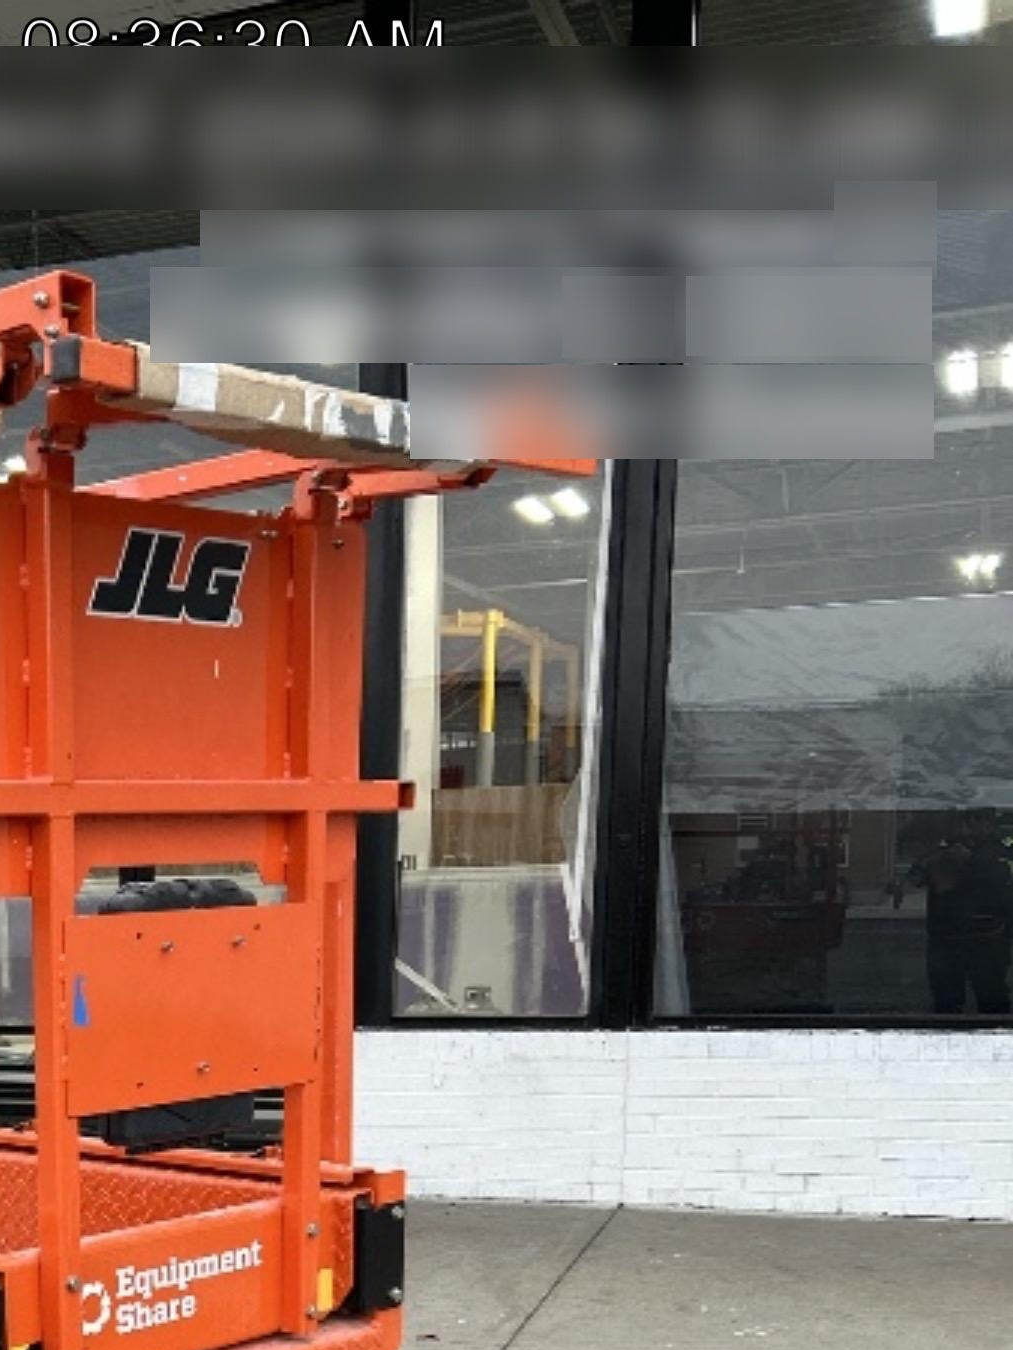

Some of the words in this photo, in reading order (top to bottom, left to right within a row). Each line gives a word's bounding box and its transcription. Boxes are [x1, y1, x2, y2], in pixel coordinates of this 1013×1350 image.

[86, 527, 251, 626] JLG
[115, 1240, 264, 1298] Equipment
[115, 1294, 197, 1335] Share
